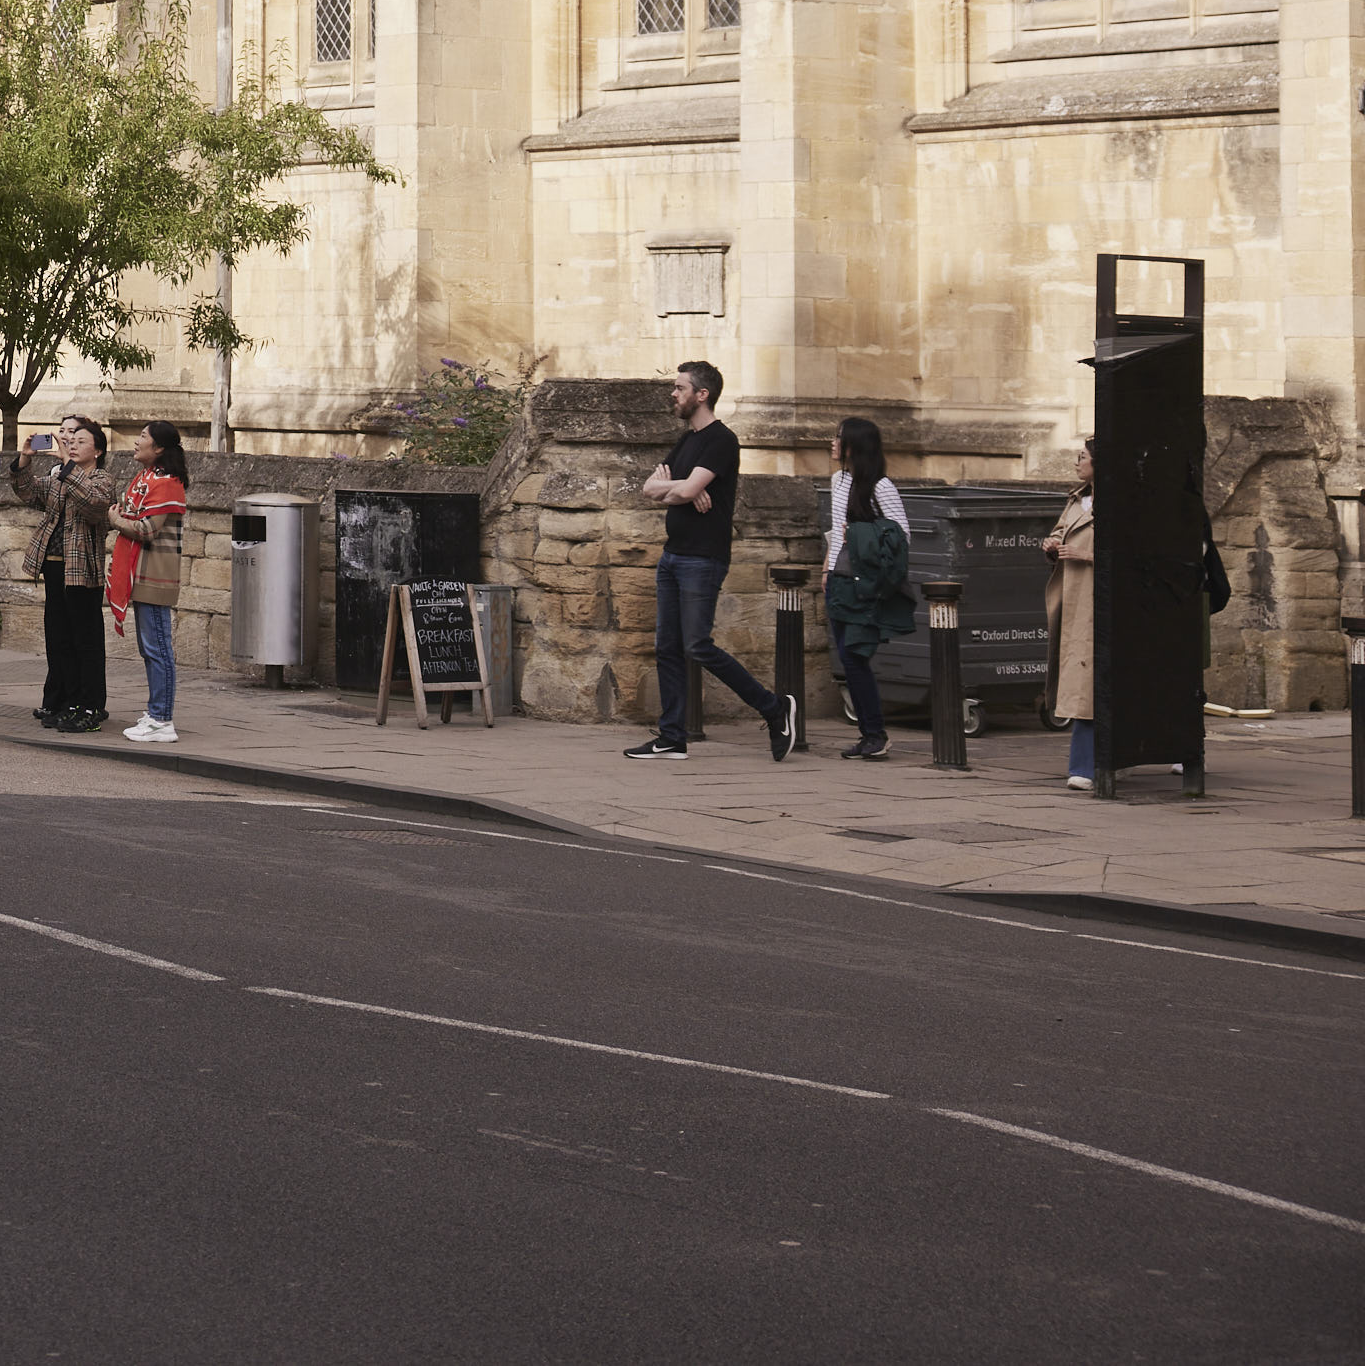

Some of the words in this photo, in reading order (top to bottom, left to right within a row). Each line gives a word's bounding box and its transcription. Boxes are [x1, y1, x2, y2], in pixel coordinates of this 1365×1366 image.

[985, 535, 1015, 548] Mixed
[438, 581, 465, 591] GARDEN
[417, 629, 474, 645] BREAKFAST
[981, 630, 1010, 641] Oxford
[1011, 629, 1036, 640] Direct
[428, 645, 462, 658] LUNCH
[422, 660, 461, 675] AFTERNOON
[461, 657, 479, 673] TEA
[996, 665, 1020, 675] 01865
